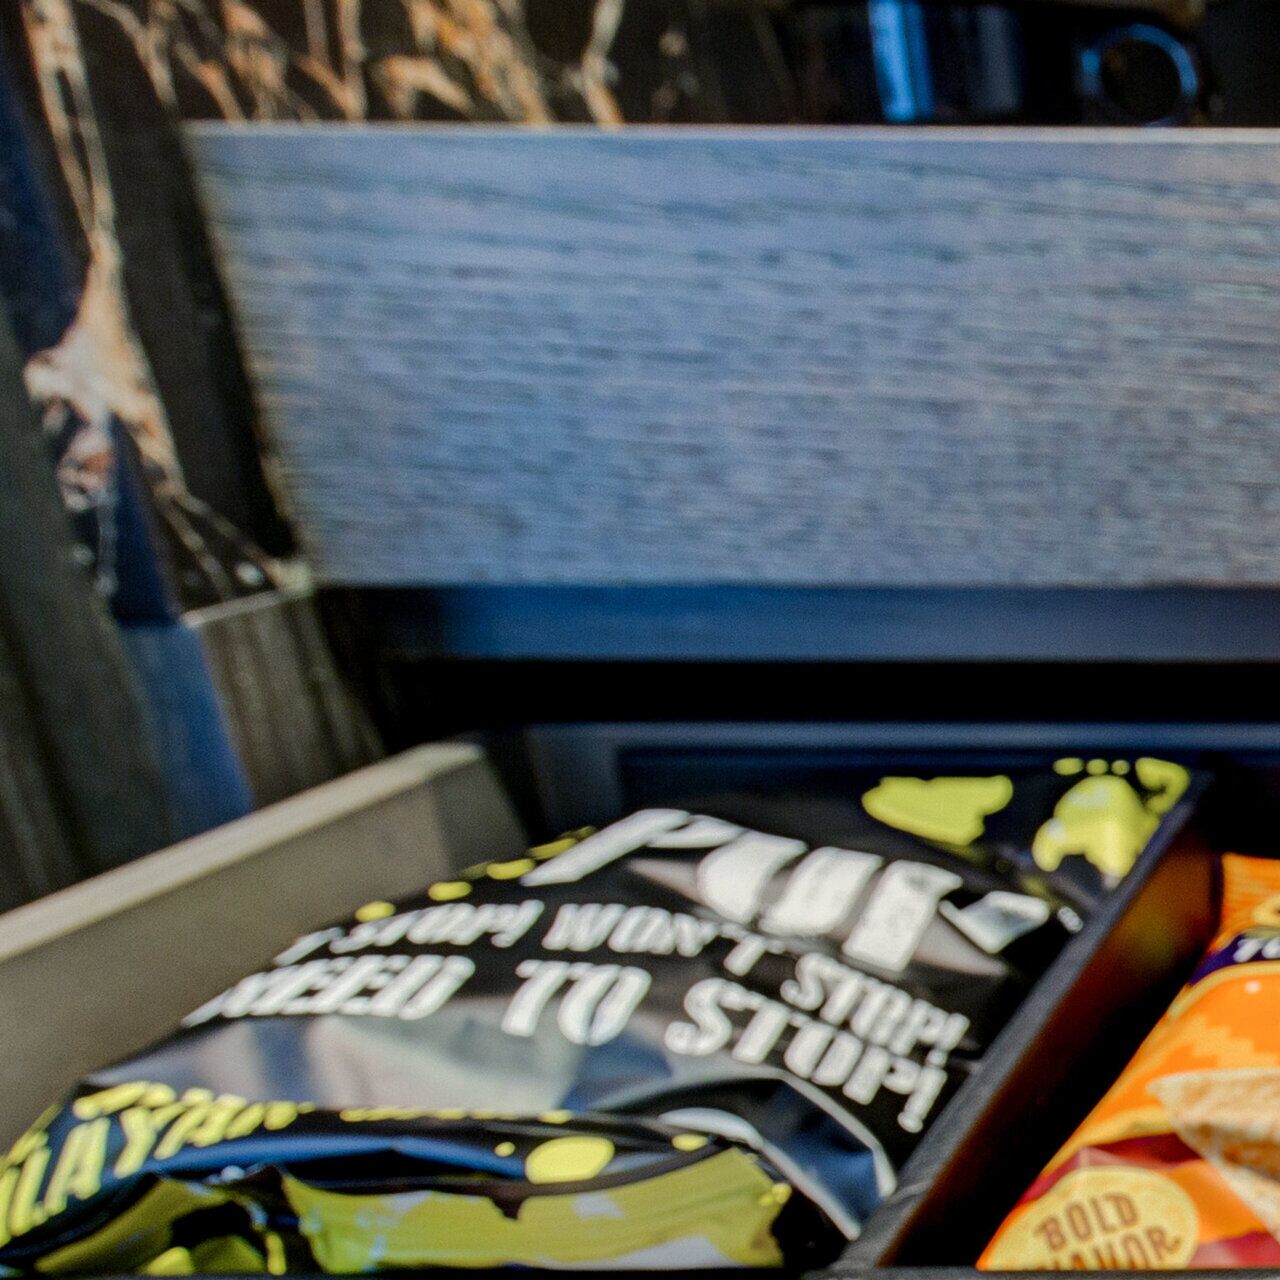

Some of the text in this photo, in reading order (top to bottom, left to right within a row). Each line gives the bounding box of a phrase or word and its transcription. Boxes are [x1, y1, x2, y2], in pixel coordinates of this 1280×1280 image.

[502, 958, 652, 1046] TO
[664, 976, 948, 1134] STOP!
[1033, 1193, 1138, 1251] BOLD
